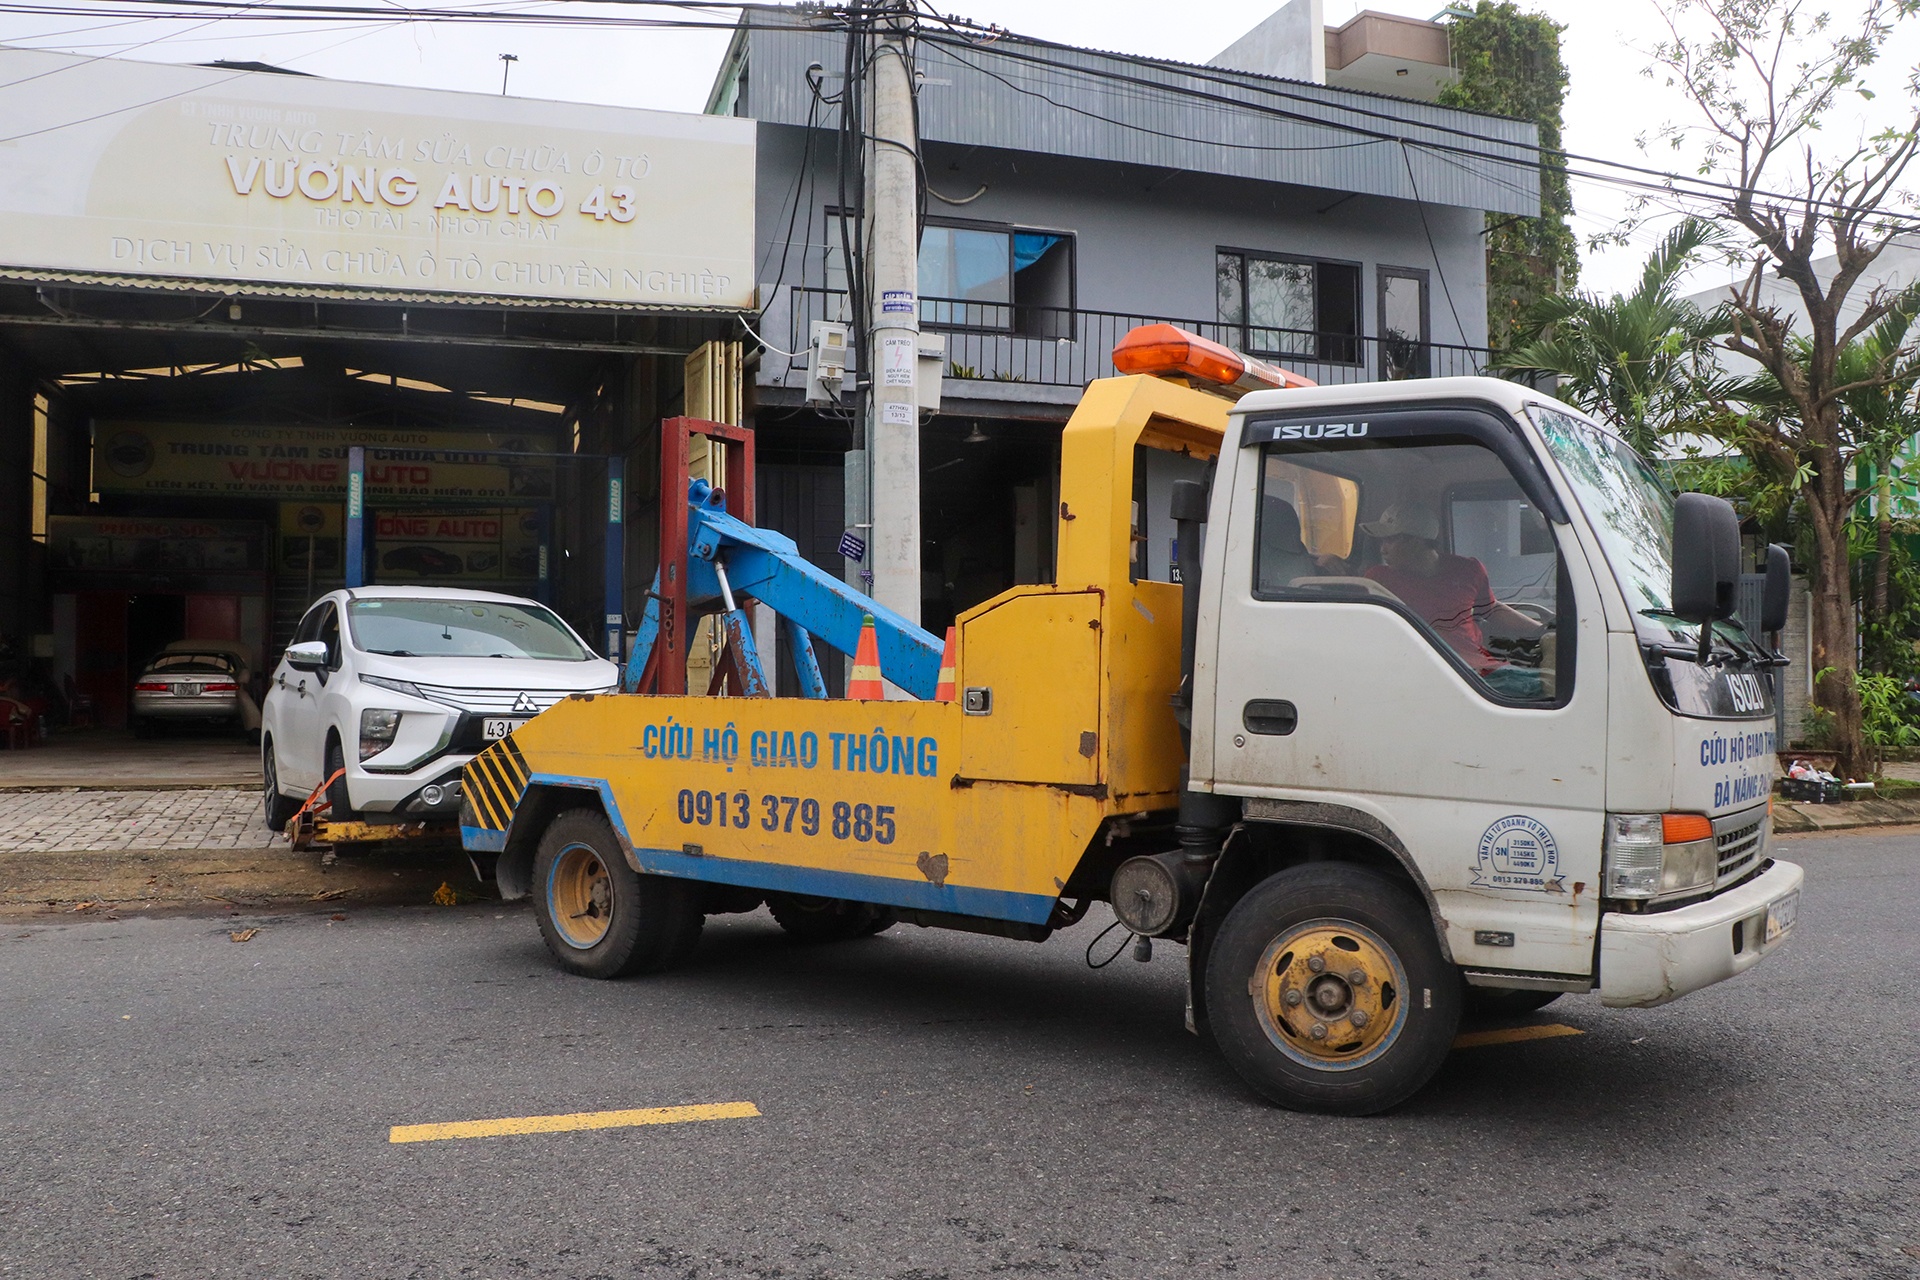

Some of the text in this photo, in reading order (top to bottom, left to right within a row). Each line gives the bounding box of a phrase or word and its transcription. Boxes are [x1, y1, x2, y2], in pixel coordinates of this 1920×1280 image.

[201, 103, 235, 119] TNHH
[285, 109, 317, 125] AUTO
[208, 121, 650, 181] TRUNG TÂM SỬA CHỮA Ô TÔ
[225, 154, 637, 223] VƯƠNG AUTO 43
[314, 207, 363, 230] THỢ
[369, 204, 404, 231] TÀI
[111, 236, 731, 299] DỊCH VỤ SỬA CHỮA Ô TÔ CHUYÊN NGHIỆP
[274, 430, 293, 439] TY
[300, 430, 336, 441] TNHH
[391, 434, 429, 444] AUTO
[1272, 422, 1369, 440] ISUZU
[167, 442, 249, 456] TRUNG
[257, 444, 309, 459] TÂM
[145, 479, 183, 490] LIÊN
[228, 459, 338, 482] VƯƠNG
[350, 472, 360, 517] TITANO
[610, 479, 620, 521] TITANO
[436, 519, 500, 538] AUTO
[1725, 673, 1765, 713] ISUZU
[643, 716, 938, 778] CỨU HỘ GIAO THÔNG
[1700, 731, 1727, 767] CỨU
[1730, 731, 1745, 769] HỘ
[1746, 733, 1764, 759] GIAO
[1714, 774, 1730, 808] ĐÀ
[677, 788, 896, 845] 0913 379 885
[1495, 847, 1508, 857] 3N
[1501, 818, 1527, 829] DOANH
[1547, 850, 1556, 865] HOA
